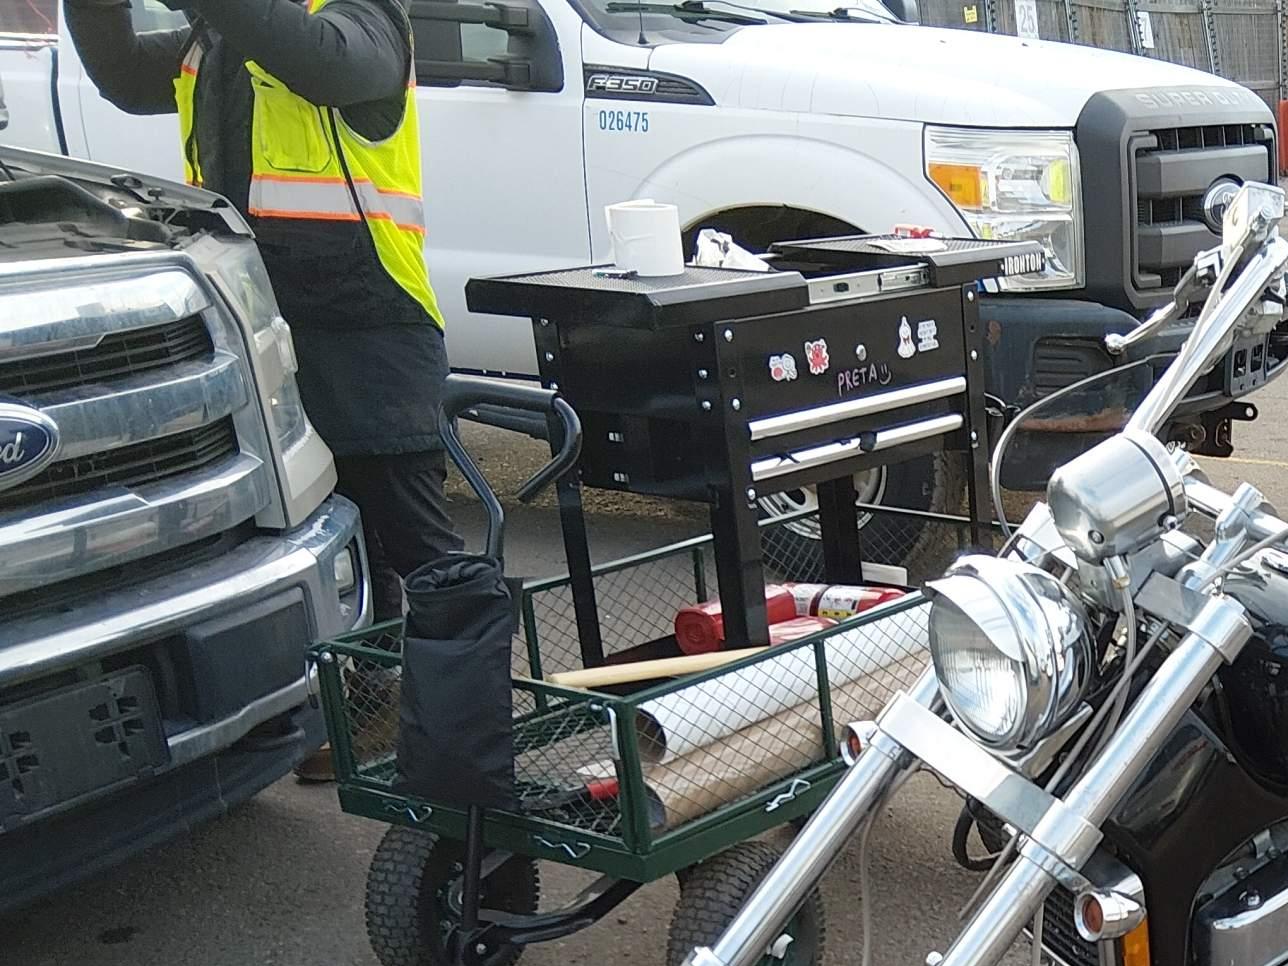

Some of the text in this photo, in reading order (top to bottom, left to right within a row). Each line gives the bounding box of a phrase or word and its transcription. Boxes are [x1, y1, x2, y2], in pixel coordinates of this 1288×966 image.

[1136, 90, 1213, 110] SUPER
[599, 110, 649, 132] 026475
[1004, 252, 1041, 276] IRONTON
[837, 363, 878, 396] PRETA
